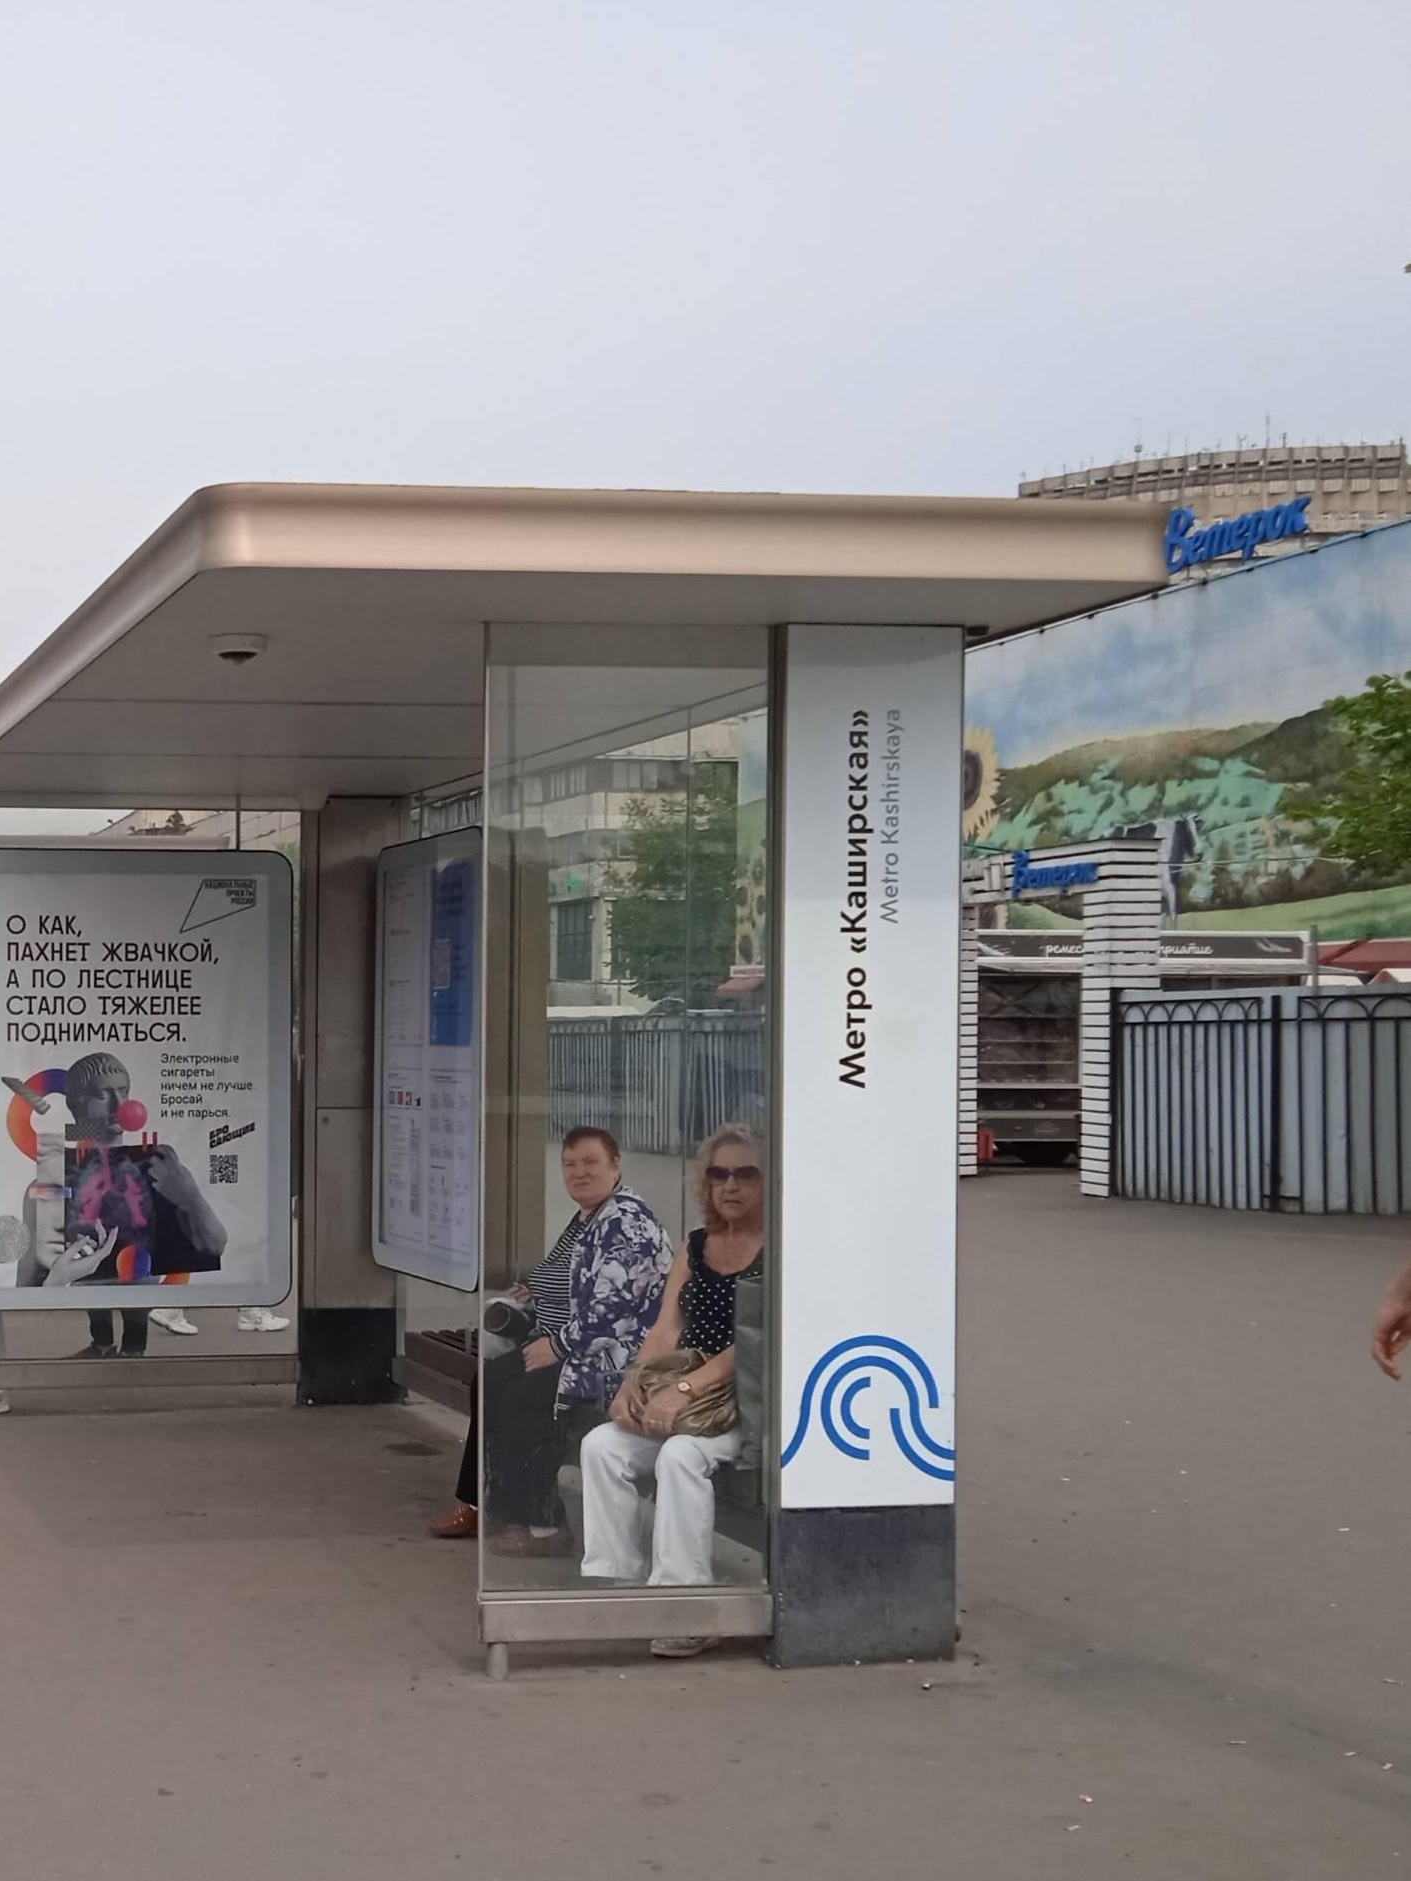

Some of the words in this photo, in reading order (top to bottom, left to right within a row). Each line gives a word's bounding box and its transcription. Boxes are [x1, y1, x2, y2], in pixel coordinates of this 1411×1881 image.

[1163, 496, 1312, 575] Ветерок
[880, 708, 906, 845] Kashirskaya
[840, 708, 875, 954] «Каширская»
[880, 851, 900, 924] Metro
[6, 914, 26, 935] О
[39, 915, 83, 937] КАК,
[6, 942, 90, 962] ПАХНЕТ
[102, 938, 219, 965] ЖВАЧКОЙ,
[1045, 944, 1084, 957] ремес
[6, 969, 20, 988] А
[32, 969, 66, 989] ПО
[77, 969, 192, 992] ЛЕСТНИЦЕ
[6, 995, 87, 1015] СТАЛО
[98, 995, 202, 1016] ТЯЖЕЛЕЕ
[6, 1022, 187, 1046] ПОДНИМАТЬСЯ.
[839, 967, 873, 1089] Метро
[160, 1052, 240, 1066] Электронные
[160, 1068, 215, 1079] сигареты
[160, 1082, 197, 1091] ничем
[200, 1083, 214, 1091] не
[160, 1094, 203, 1106] Бросай
[160, 1109, 168, 1118] и
[170, 1109, 185, 1118] не
[187, 1108, 231, 1120] парься.
[209, 1124, 230, 1140] БРО
[209, 1121, 256, 1149] САЮЩИЕ
